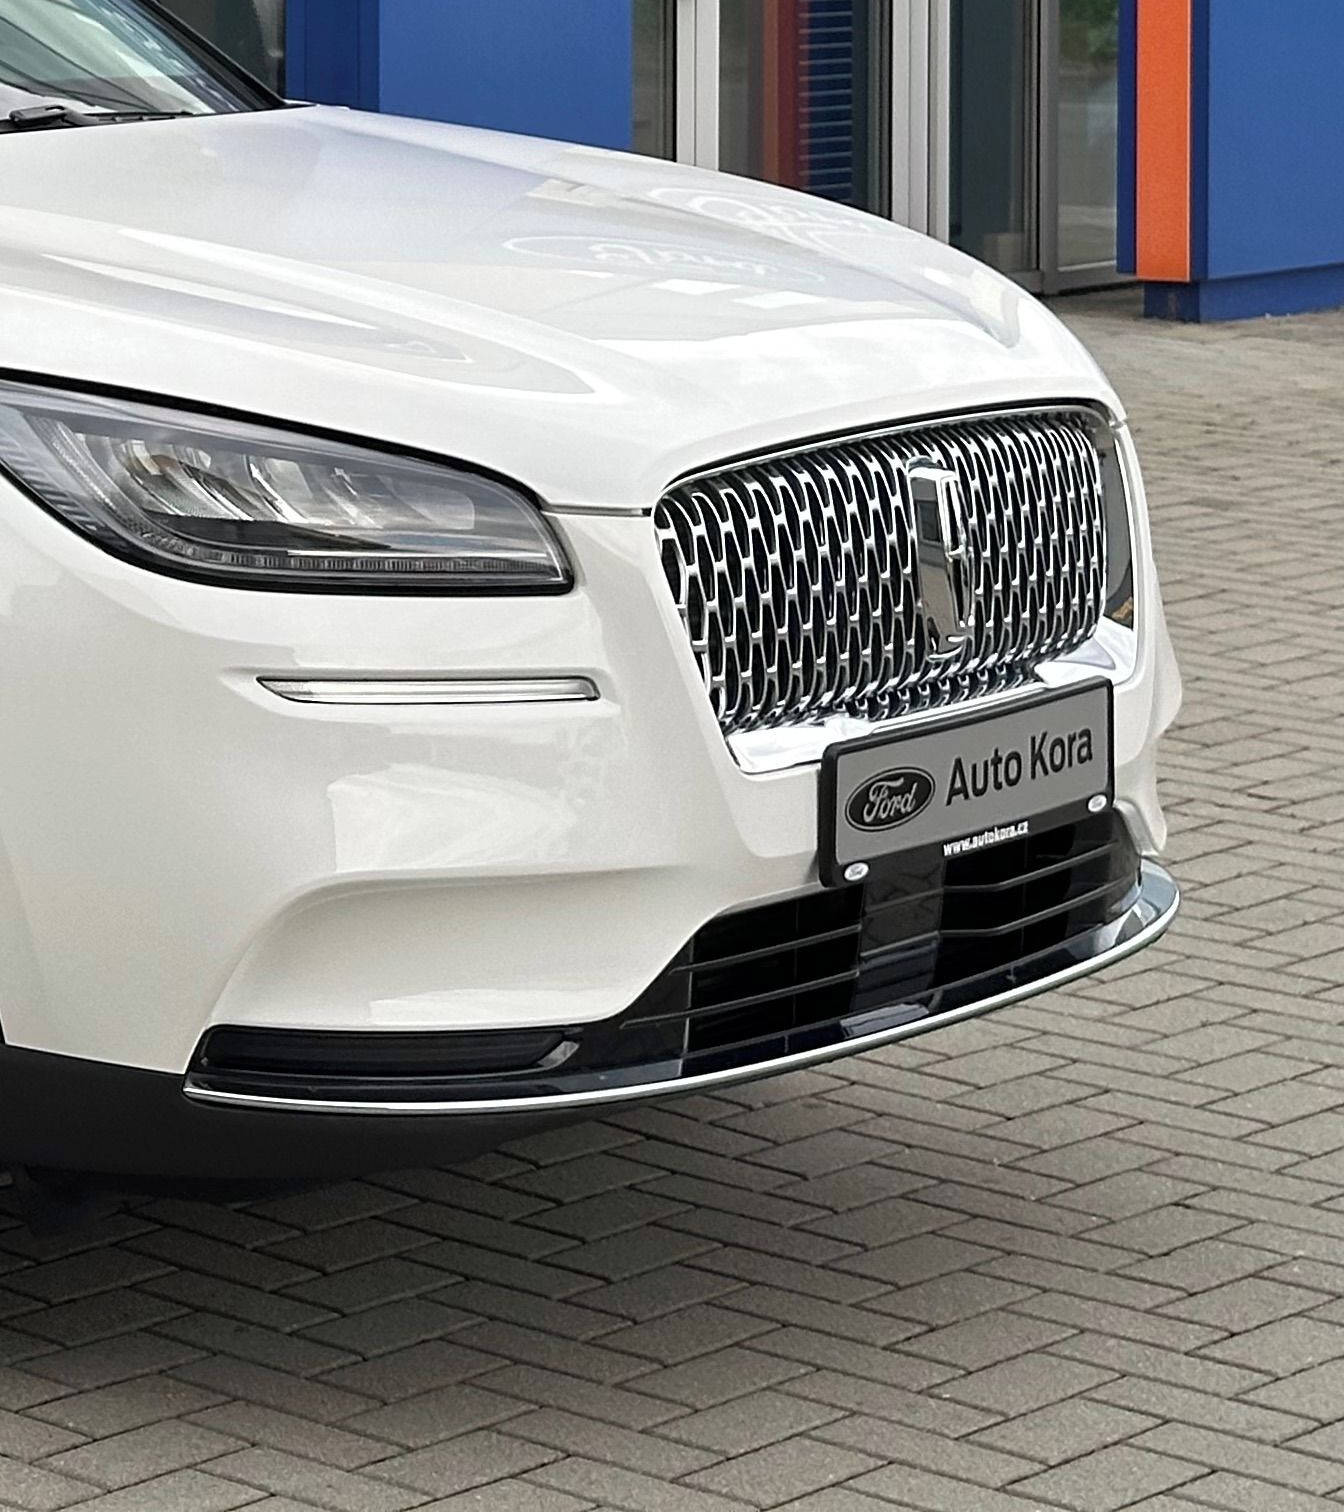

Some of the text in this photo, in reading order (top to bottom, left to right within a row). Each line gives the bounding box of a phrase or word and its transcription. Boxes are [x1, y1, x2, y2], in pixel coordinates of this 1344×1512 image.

[863, 727, 1094, 823] Ford Auto Kora
[943, 820, 1029, 857] www.autokora.cz
